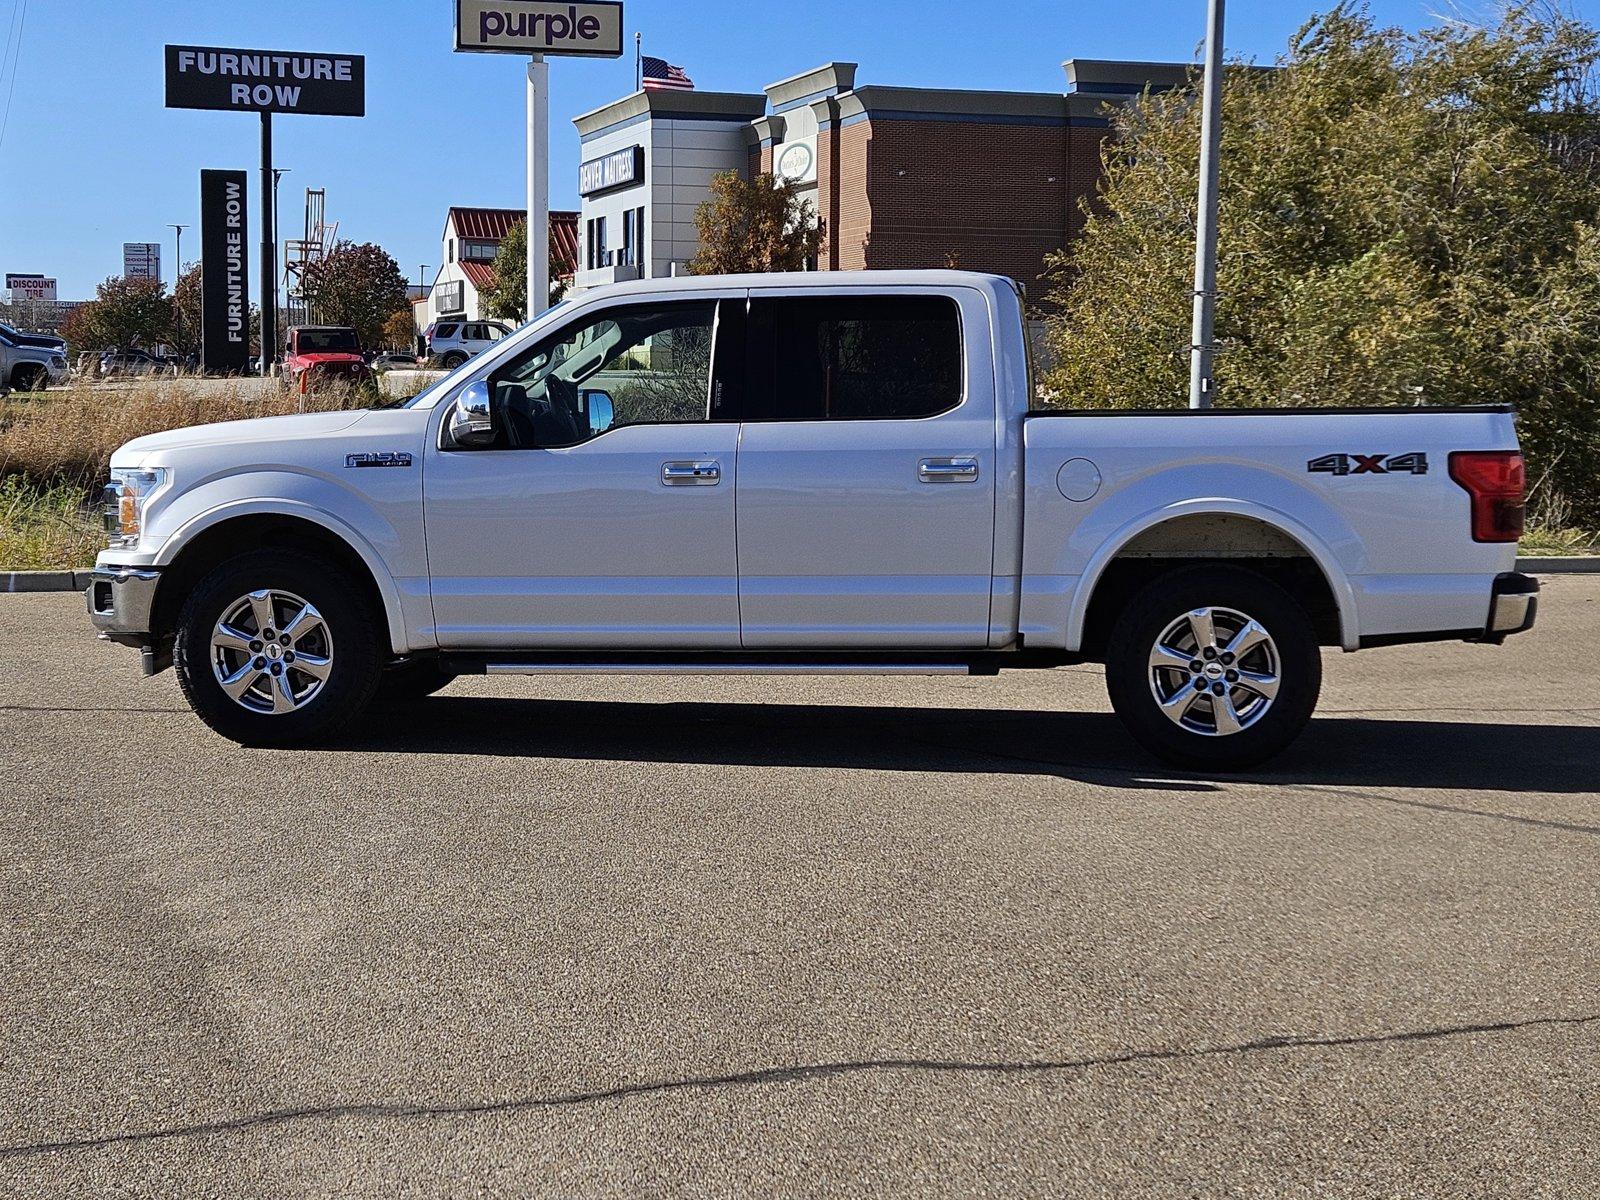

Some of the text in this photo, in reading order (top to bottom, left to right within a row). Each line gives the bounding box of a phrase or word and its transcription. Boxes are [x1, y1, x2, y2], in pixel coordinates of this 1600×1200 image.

[480, 6, 600, 45] purple
[178, 51, 353, 81] FURNITURE
[231, 83, 302, 107] ROW
[580, 149, 633, 195] DENVER MATTRESS
[130, 266, 149, 274] Jeep
[226, 181, 243, 342] FURNITURE ROW
[13, 280, 55, 289] DISCOUNT
[25, 289, 44, 298] TIRE
